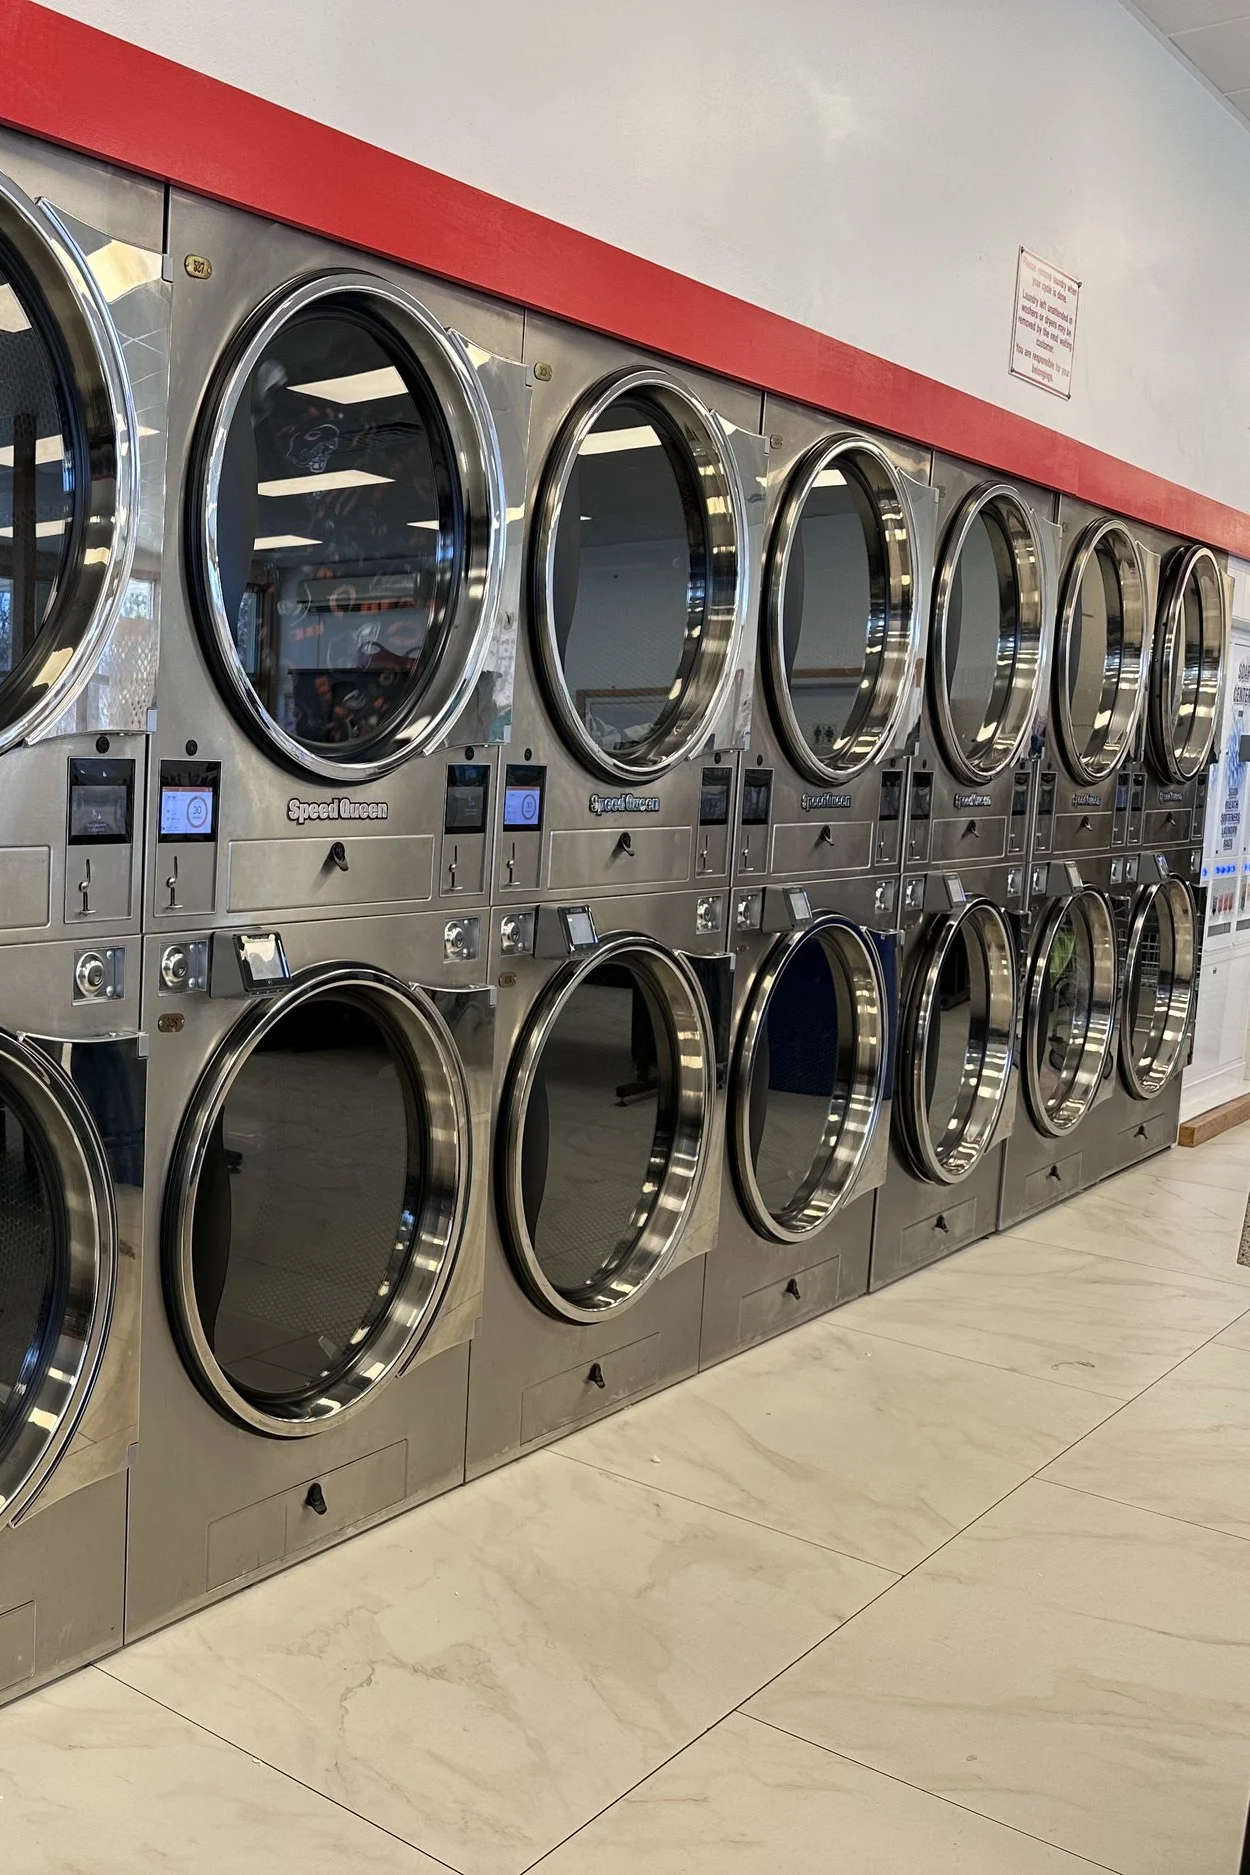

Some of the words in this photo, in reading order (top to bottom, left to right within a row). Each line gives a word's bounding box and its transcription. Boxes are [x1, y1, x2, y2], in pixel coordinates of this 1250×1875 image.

[193, 259, 205, 274] 527
[1032, 277, 1041, 288] your
[1042, 283, 1052, 295] cycle
[1053, 276, 1066, 291] laundry
[1067, 285, 1077, 296] when
[1023, 288, 1038, 307] Laundry
[1047, 304, 1069, 323] unattended
[1018, 315, 1036, 331] removed
[1036, 323, 1042, 335] by
[1050, 332, 1059, 343] next
[1022, 304, 1038, 319] washers
[1039, 313, 1044, 321] or
[1045, 315, 1057, 329] dryers
[1058, 323, 1066, 335] may
[1066, 326, 1071, 337] be
[1032, 352, 1054, 370] responsible
[193, 805, 202, 815] 30
[287, 798, 340, 825] Speed
[340, 797, 388, 819] Queen
